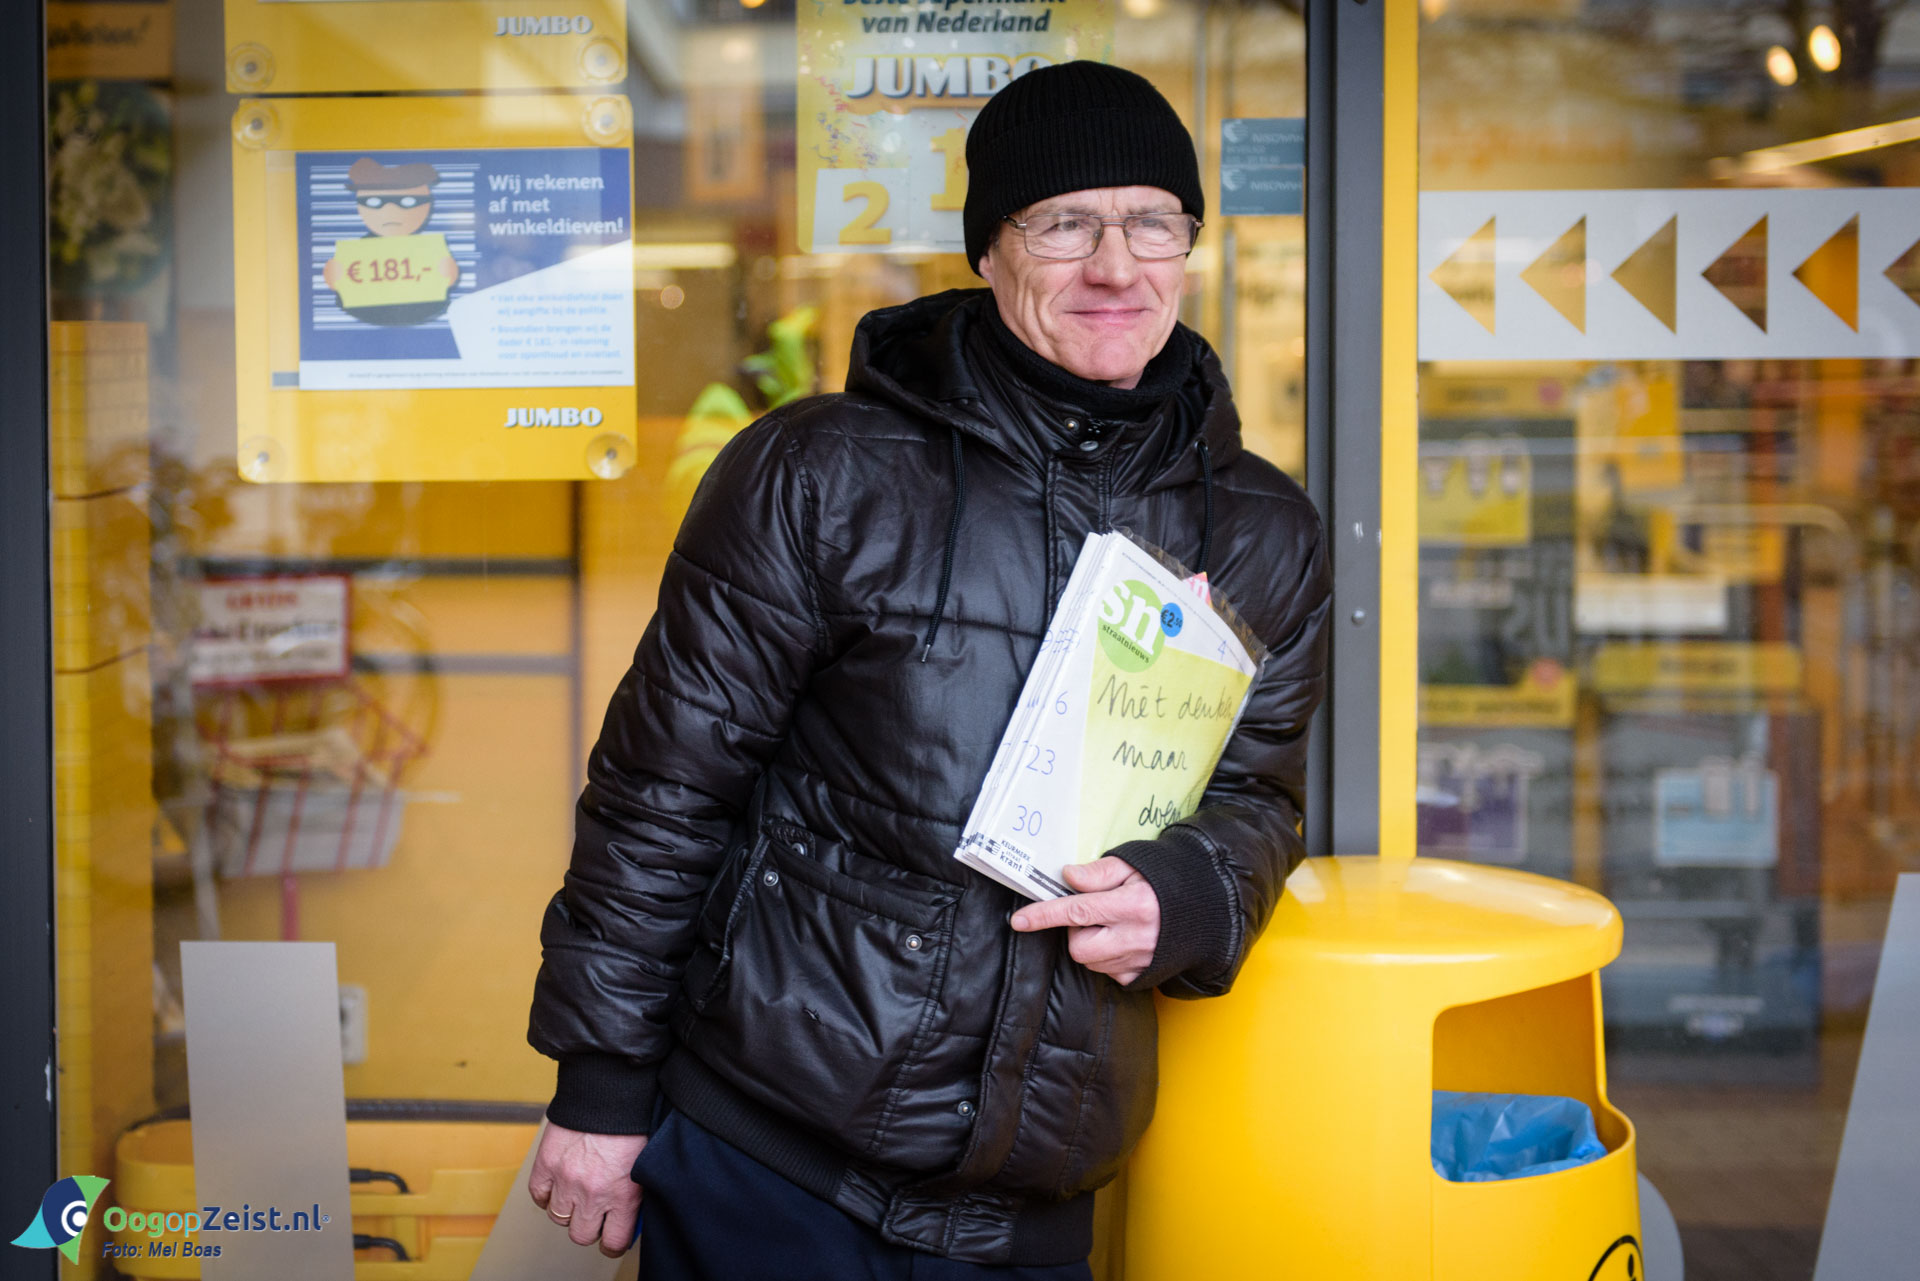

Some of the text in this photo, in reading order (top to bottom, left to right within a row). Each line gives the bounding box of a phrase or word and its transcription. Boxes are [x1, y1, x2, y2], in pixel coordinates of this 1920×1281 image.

[494, 15, 594, 36] JUMBO
[862, 8, 1053, 33] van Nederland
[488, 174, 605, 194] Wij rekenen
[488, 197, 551, 213] af met
[838, 181, 892, 245] 2
[488, 217, 625, 236] winkeldieven!
[347, 257, 432, 283] € 181,-
[504, 406, 604, 428] JUMBO
[1098, 580, 1163, 657] sn
[1102, 624, 1150, 664] straatnieuws
[1113, 740, 1188, 771] maar
[1012, 805, 1043, 836] 30
[1000, 850, 1023, 872] krant
[1001, 839, 1031, 862] KEURMERK
